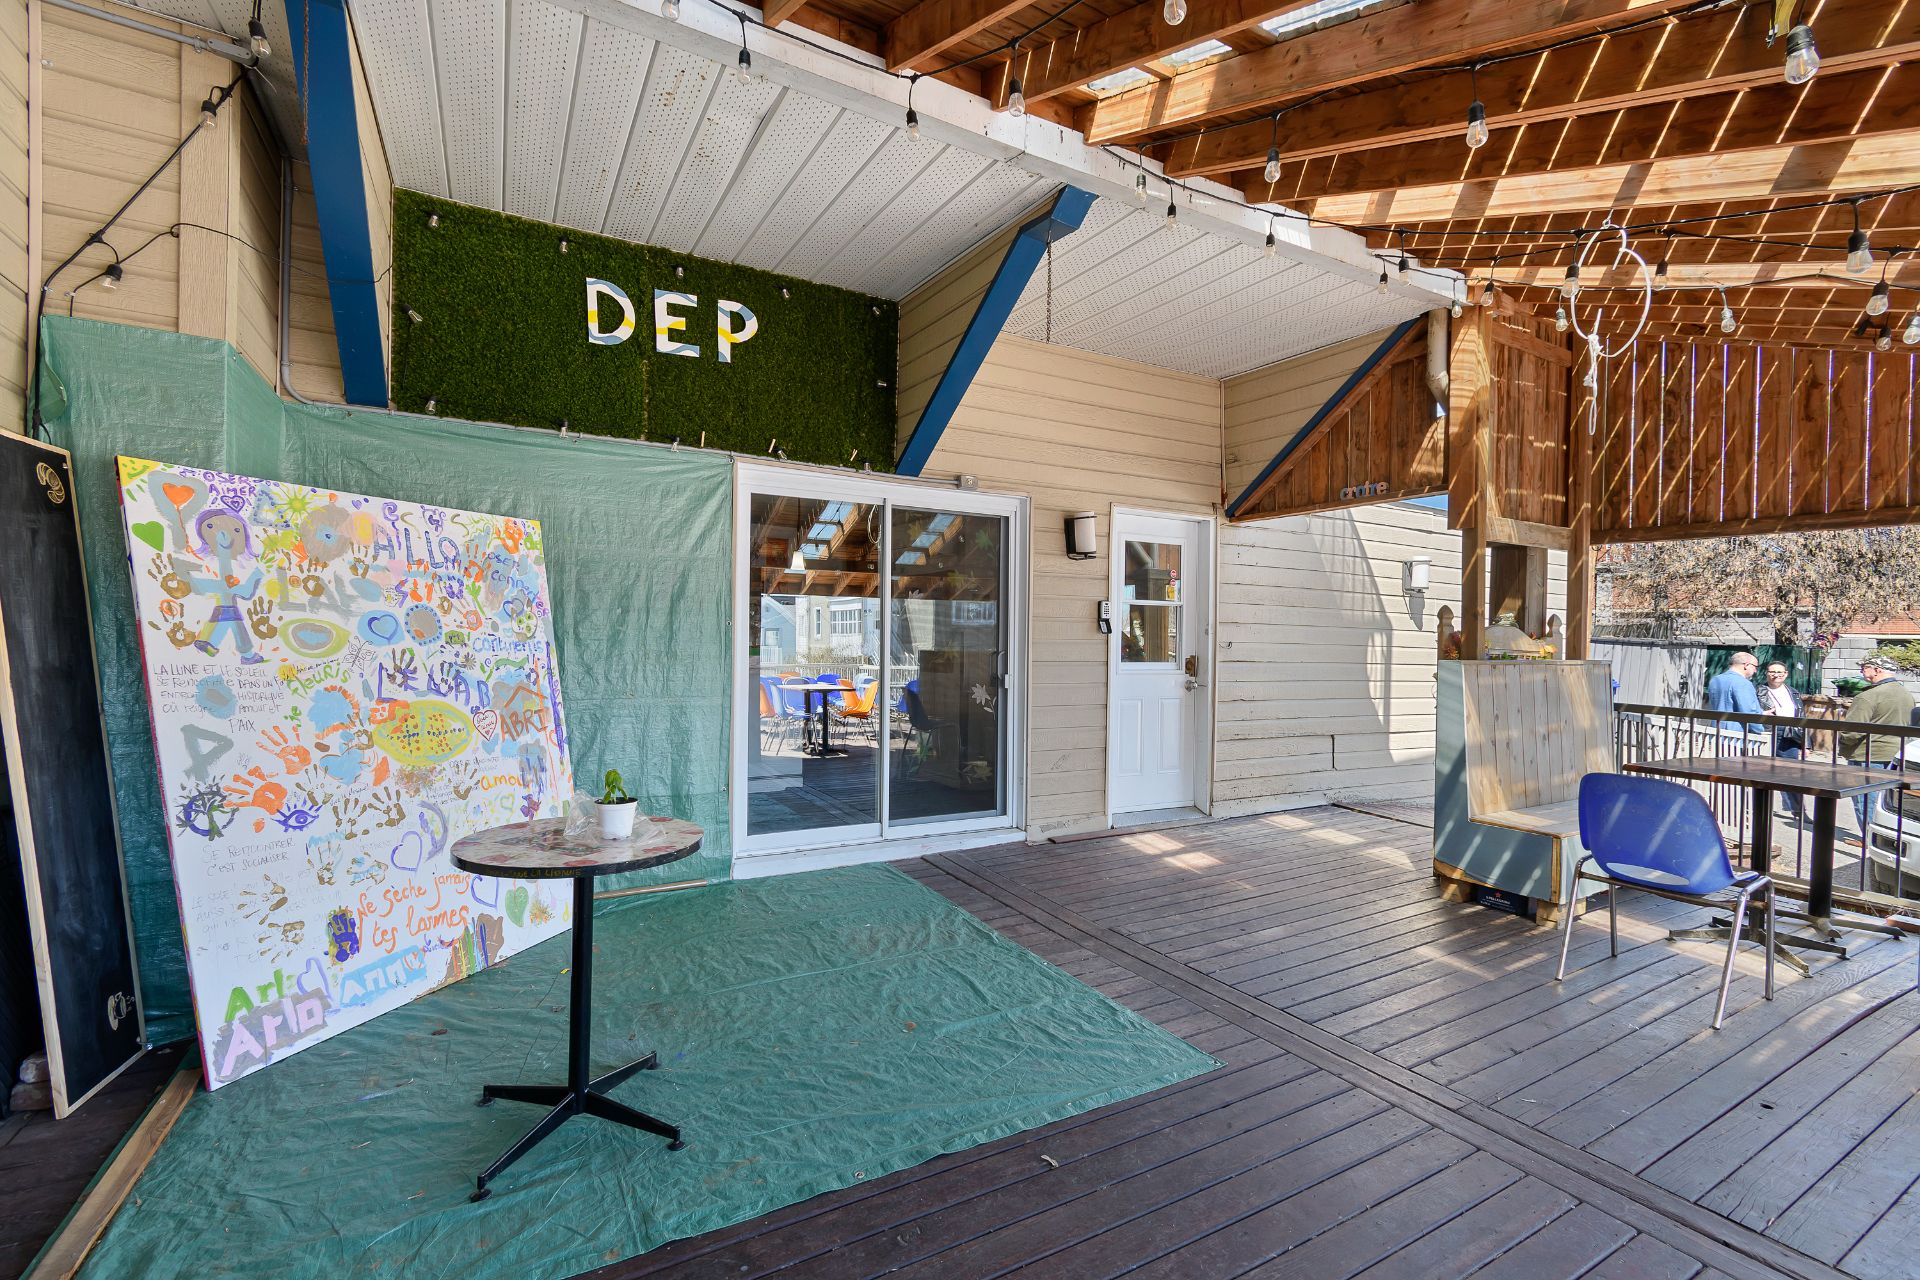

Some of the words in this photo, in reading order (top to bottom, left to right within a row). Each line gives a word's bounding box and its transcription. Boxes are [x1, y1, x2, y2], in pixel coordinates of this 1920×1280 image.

[208, 484, 257, 497] AIMER
[170, 663, 199, 676] LUNE
[202, 664, 217, 676] ET
